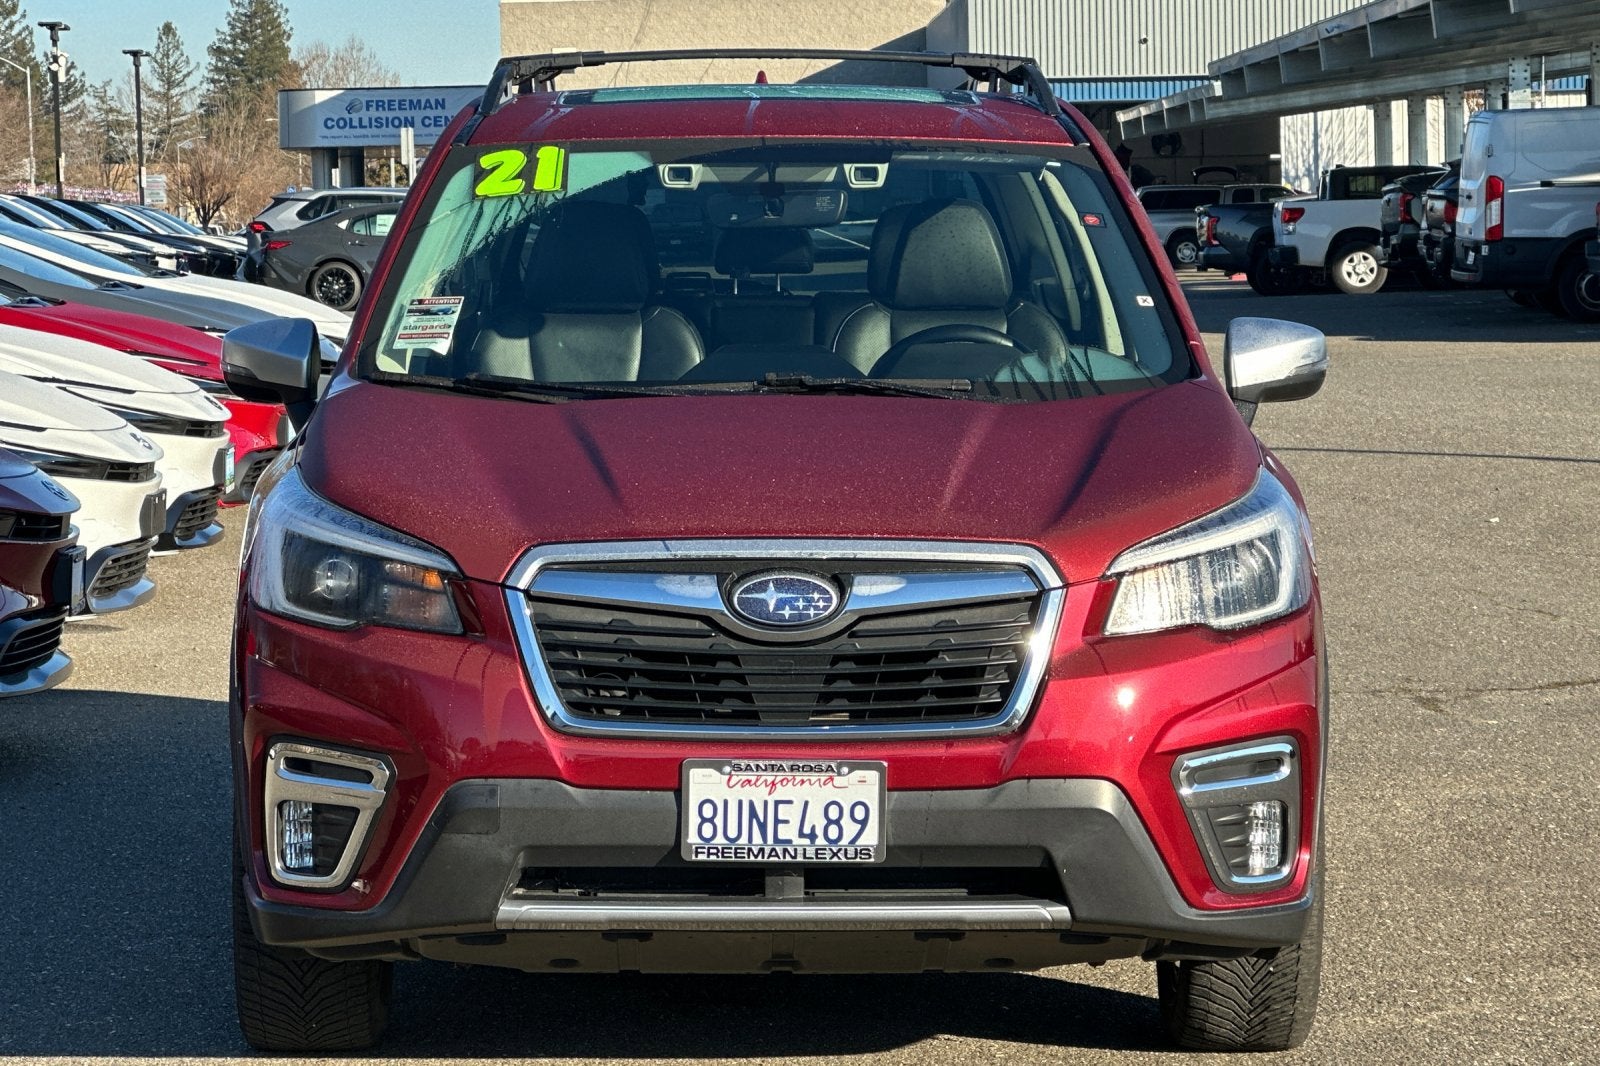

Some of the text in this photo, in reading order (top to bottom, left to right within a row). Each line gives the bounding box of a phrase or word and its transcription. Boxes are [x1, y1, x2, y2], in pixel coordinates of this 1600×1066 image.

[365, 98, 446, 112] FREEMAN
[323, 115, 415, 129] COLLISION
[475, 146, 565, 197] 21
[732, 763, 836, 773] SANTA ROSA
[726, 774, 848, 796] California
[697, 798, 870, 845] 8UNE489
[694, 846, 872, 860] FREEMAN LEXUS
